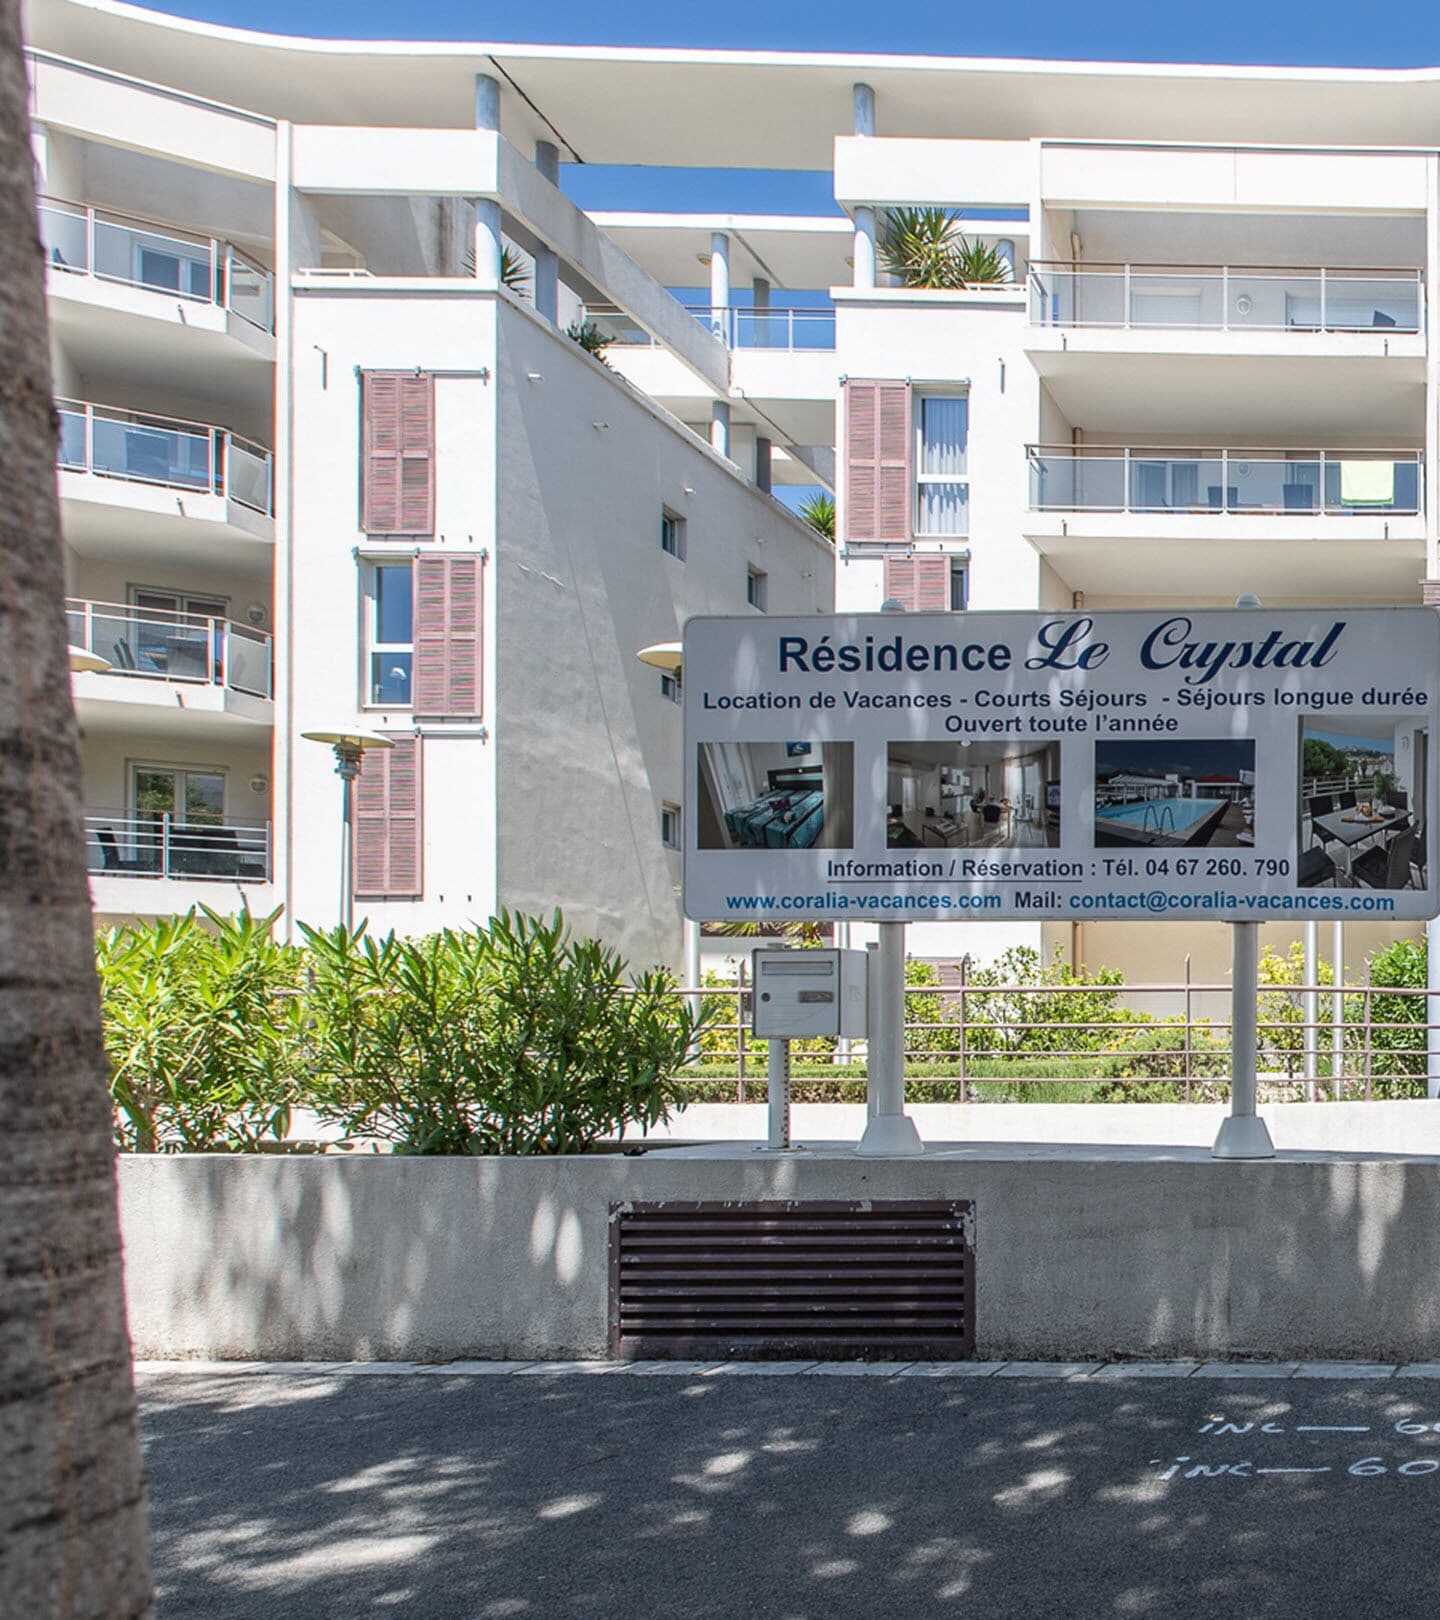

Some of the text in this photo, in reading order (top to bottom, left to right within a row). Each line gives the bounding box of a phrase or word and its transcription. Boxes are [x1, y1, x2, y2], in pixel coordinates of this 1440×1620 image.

[779, 617, 1347, 685] Résidence Le Crystal
[703, 692, 801, 710] Location
[809, 691, 836, 709] de
[843, 690, 952, 709] Vacances
[974, 689, 1051, 709] Courts
[1059, 689, 1147, 711] Séjours
[1177, 688, 1266, 710] Séjours
[1274, 687, 1354, 710] longue
[1361, 687, 1428, 706] durée
[945, 715, 1022, 733] Ouvert
[1029, 715, 1088, 732] toute
[827, 859, 943, 877] Information
[962, 859, 1083, 877] Réservation
[1102, 859, 1138, 876] Tél.
[1145, 859, 1169, 876] 04
[1175, 859, 1199, 876] 67
[1254, 859, 1290, 876] 790
[726, 891, 1394, 912] www.coralia-vacances.com Mail: contact@coralia-vacances.com
